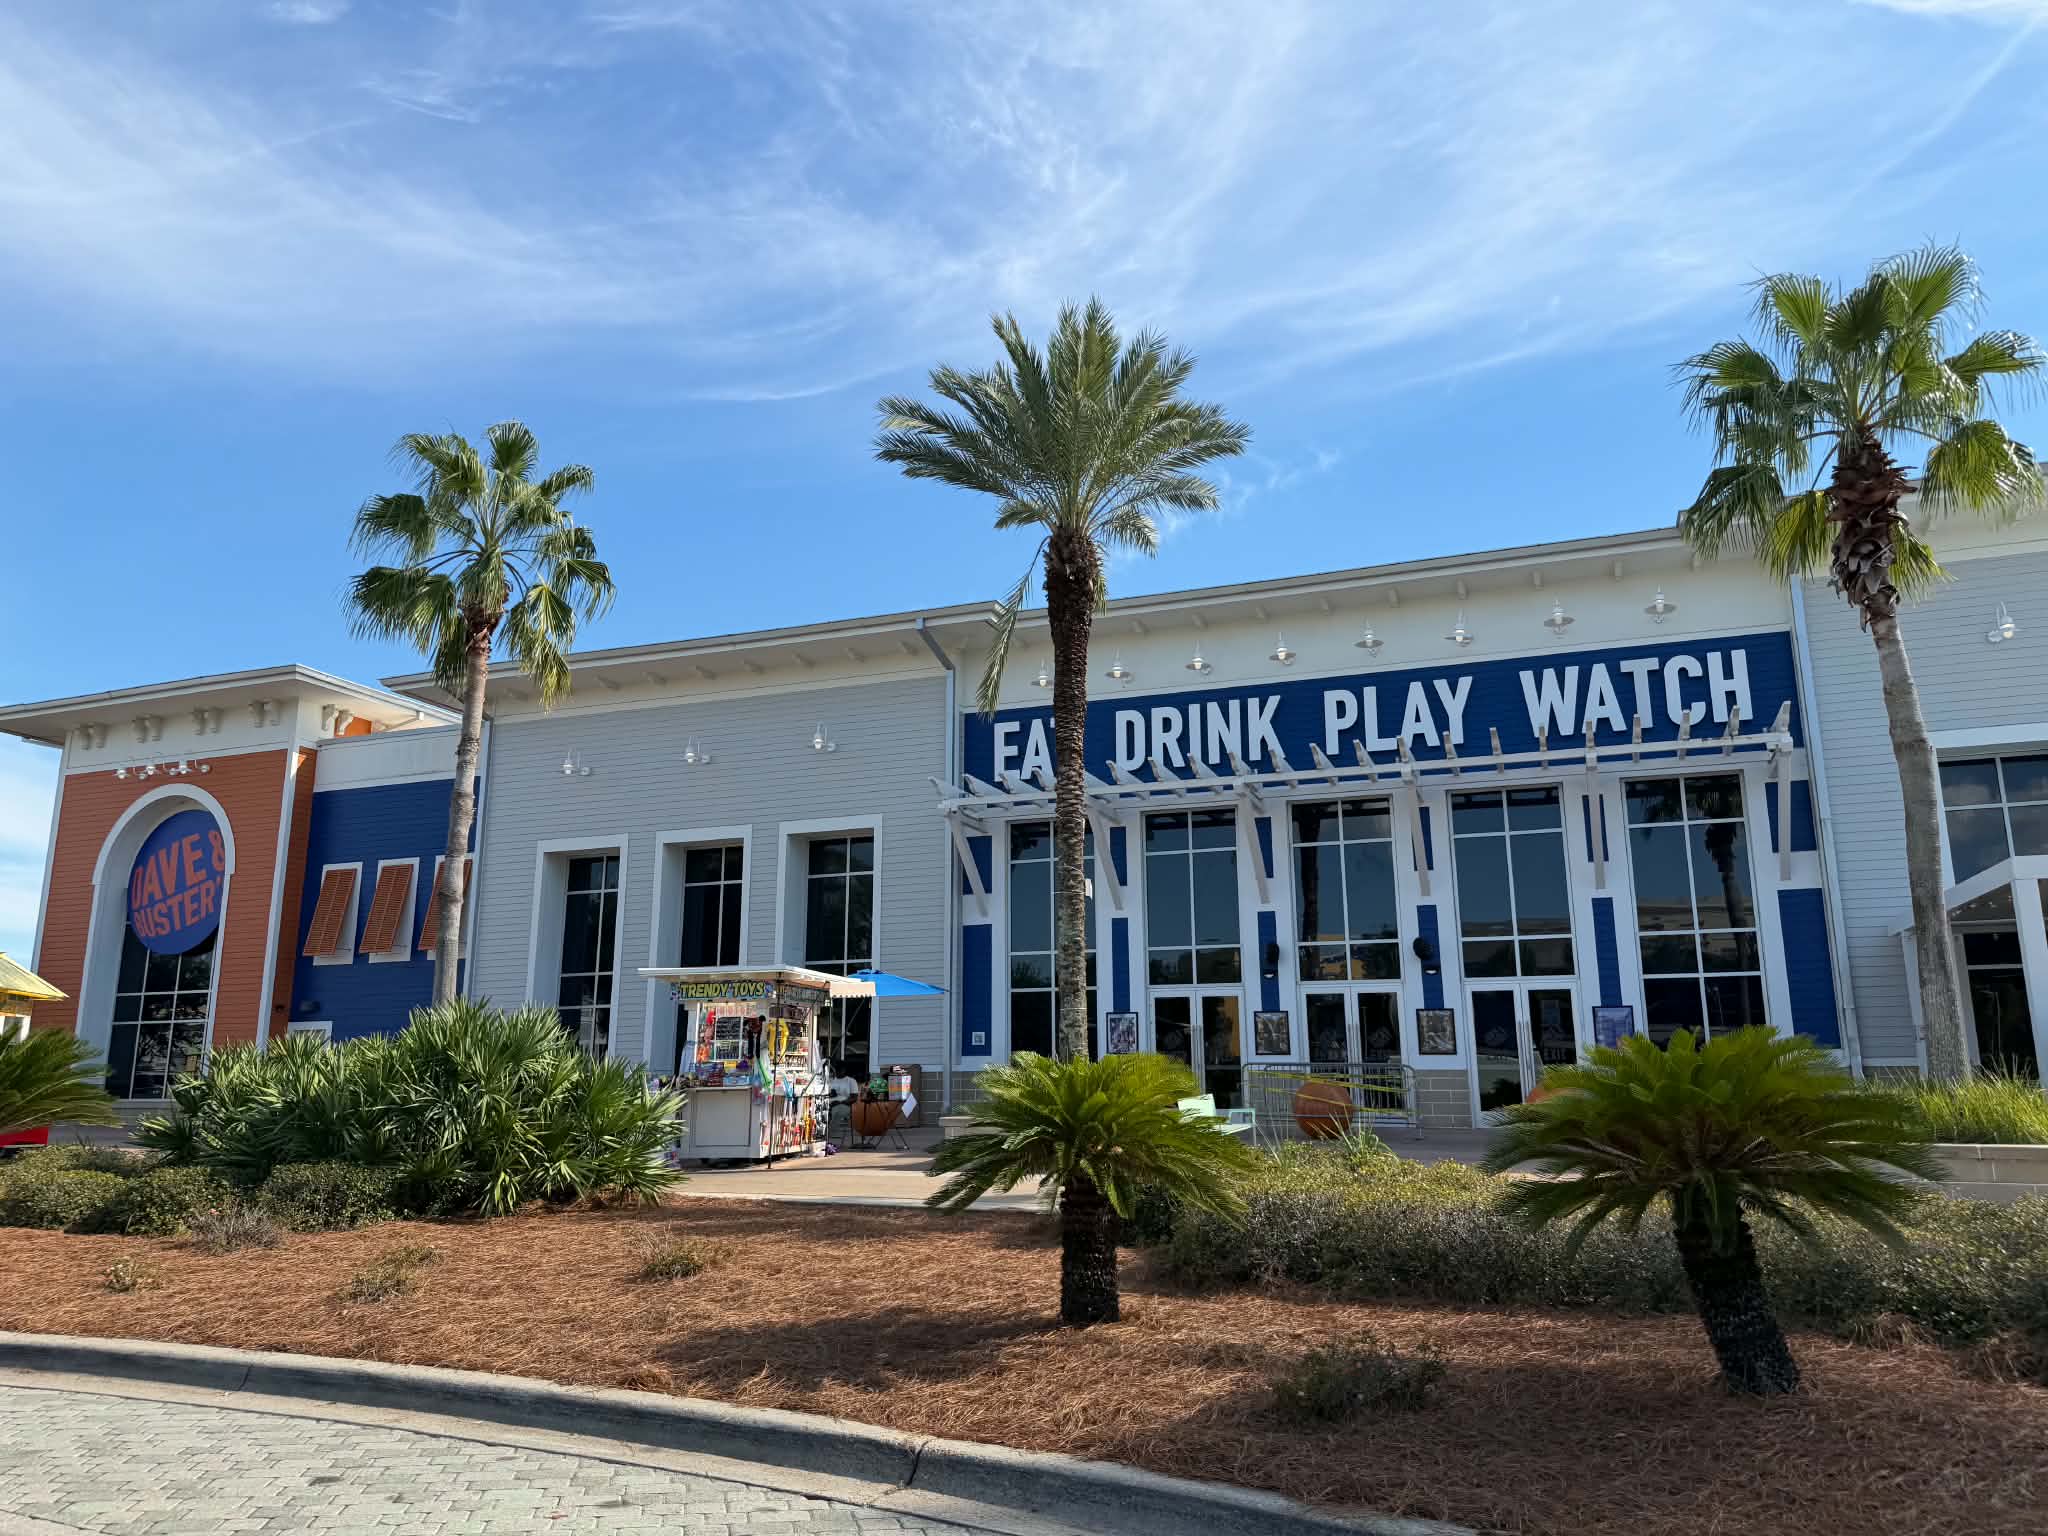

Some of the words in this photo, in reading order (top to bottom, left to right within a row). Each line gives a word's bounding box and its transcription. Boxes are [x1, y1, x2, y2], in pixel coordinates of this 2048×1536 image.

[994, 717, 1056, 782] EA
[1115, 695, 1286, 772] DRINK
[1323, 676, 1473, 755] PLAY
[1518, 649, 1754, 738] WATCH
[131, 833, 207, 910] DAVE
[208, 830, 225, 872] &
[134, 877, 222, 937] BUSTER'
[680, 983, 729, 998] TRENDY
[733, 982, 765, 997] TOYS
